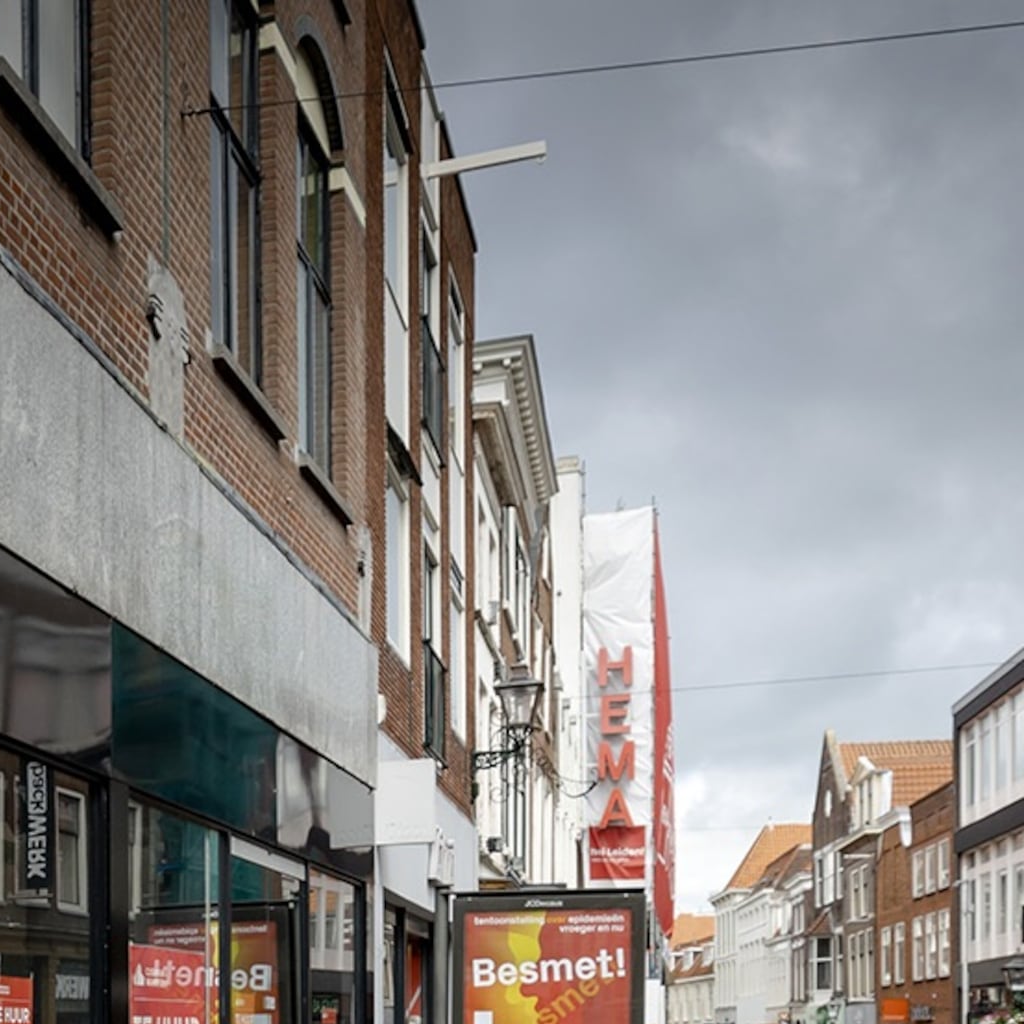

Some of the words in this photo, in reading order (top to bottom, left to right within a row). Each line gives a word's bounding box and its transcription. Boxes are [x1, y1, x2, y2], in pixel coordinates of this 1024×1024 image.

[596, 646, 635, 828] HEMA
[559, 924, 595, 934] vroeger
[597, 924, 610, 932] en
[611, 924, 624, 932] nu
[472, 947, 626, 988] Besmet!
[4, 1006, 31, 1024] HUUR
